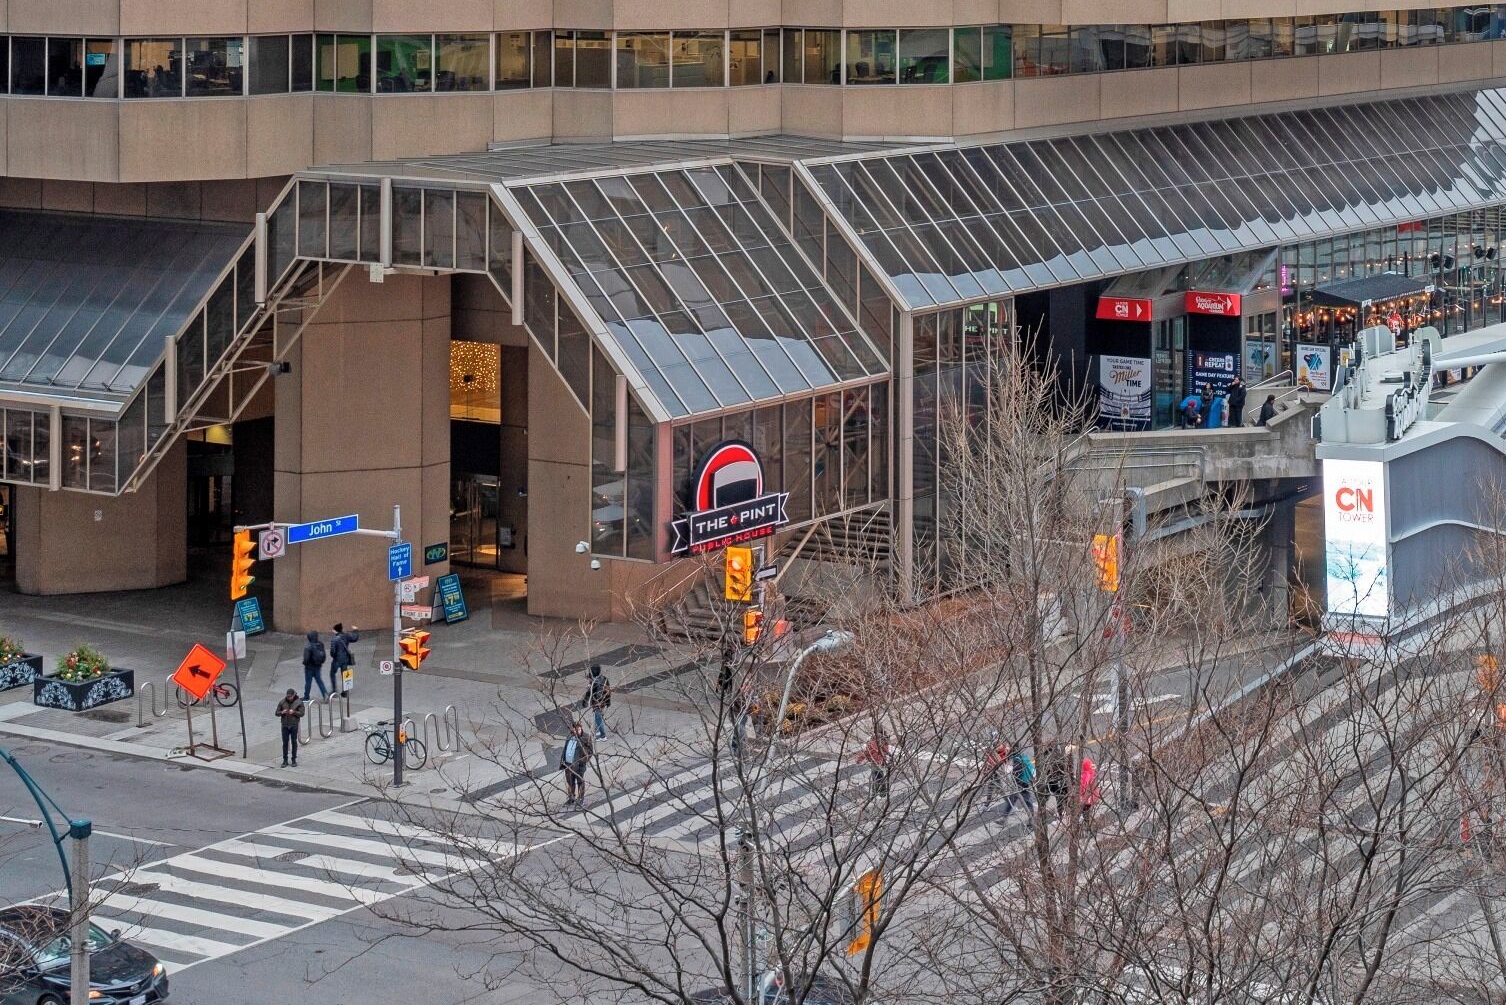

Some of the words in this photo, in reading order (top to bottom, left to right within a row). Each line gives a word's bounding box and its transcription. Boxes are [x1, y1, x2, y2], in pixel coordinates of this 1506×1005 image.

[1115, 305, 1128, 313] CN
[1109, 369, 1142, 385] Miller
[1126, 379, 1142, 388] TIME
[1335, 487, 1373, 512] CN
[696, 516, 728, 534] THE
[740, 503, 776, 523] PINT
[1338, 512, 1373, 523] TOWER
[308, 522, 333, 537] John
[691, 538, 732, 553] PUBLIC
[735, 525, 773, 542] HOUSE
[390, 546, 410, 555] Hockey
[390, 554, 402, 562] Hall
[392, 559, 408, 567] Fame
